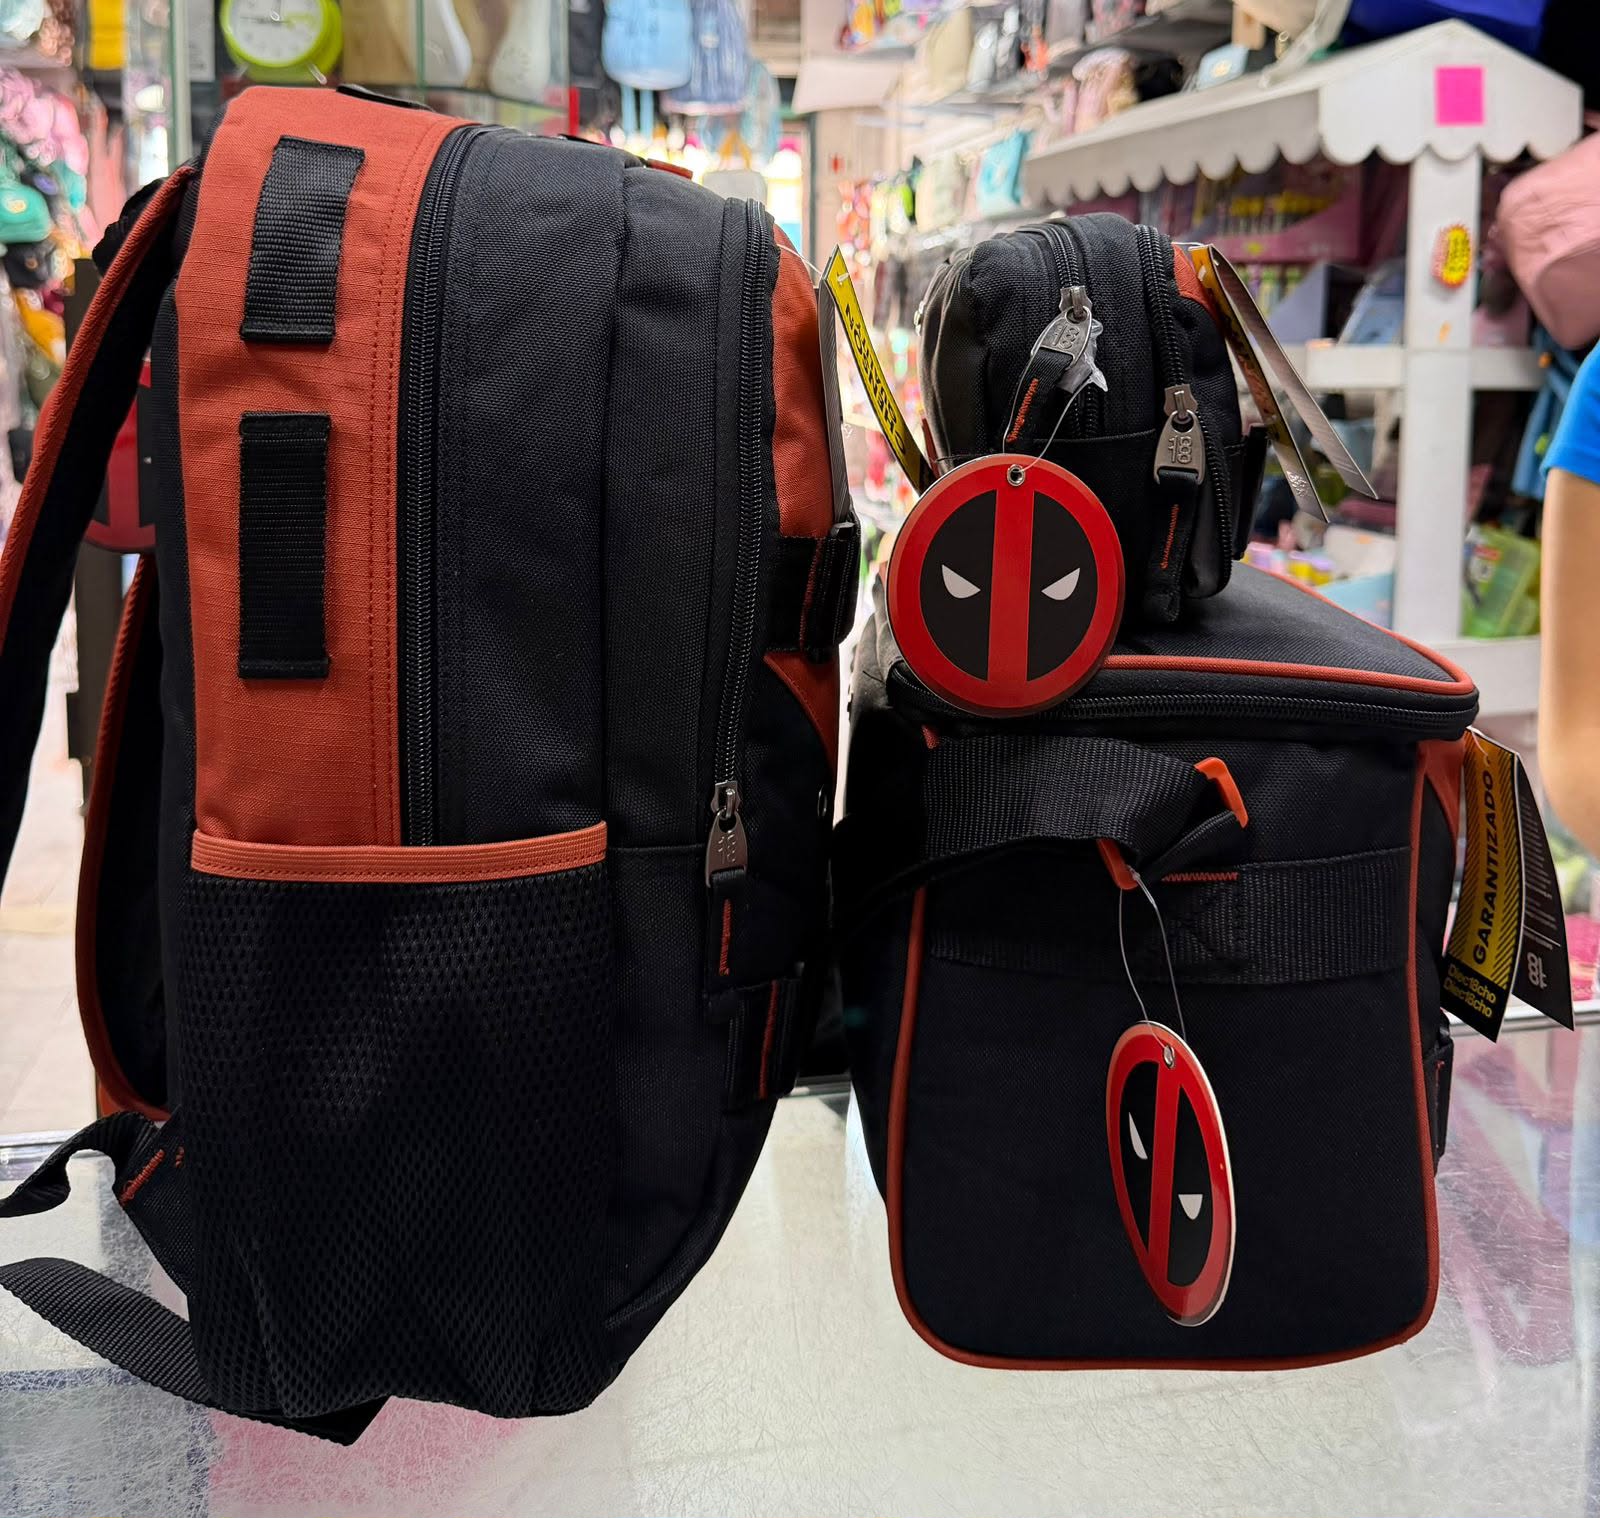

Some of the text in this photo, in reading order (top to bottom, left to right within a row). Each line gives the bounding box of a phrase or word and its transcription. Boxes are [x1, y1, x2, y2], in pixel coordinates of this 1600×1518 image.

[844, 302, 906, 456] CHENSON
[1167, 434, 1193, 464] 18
[1472, 774, 1498, 965] GARANTIZADO
